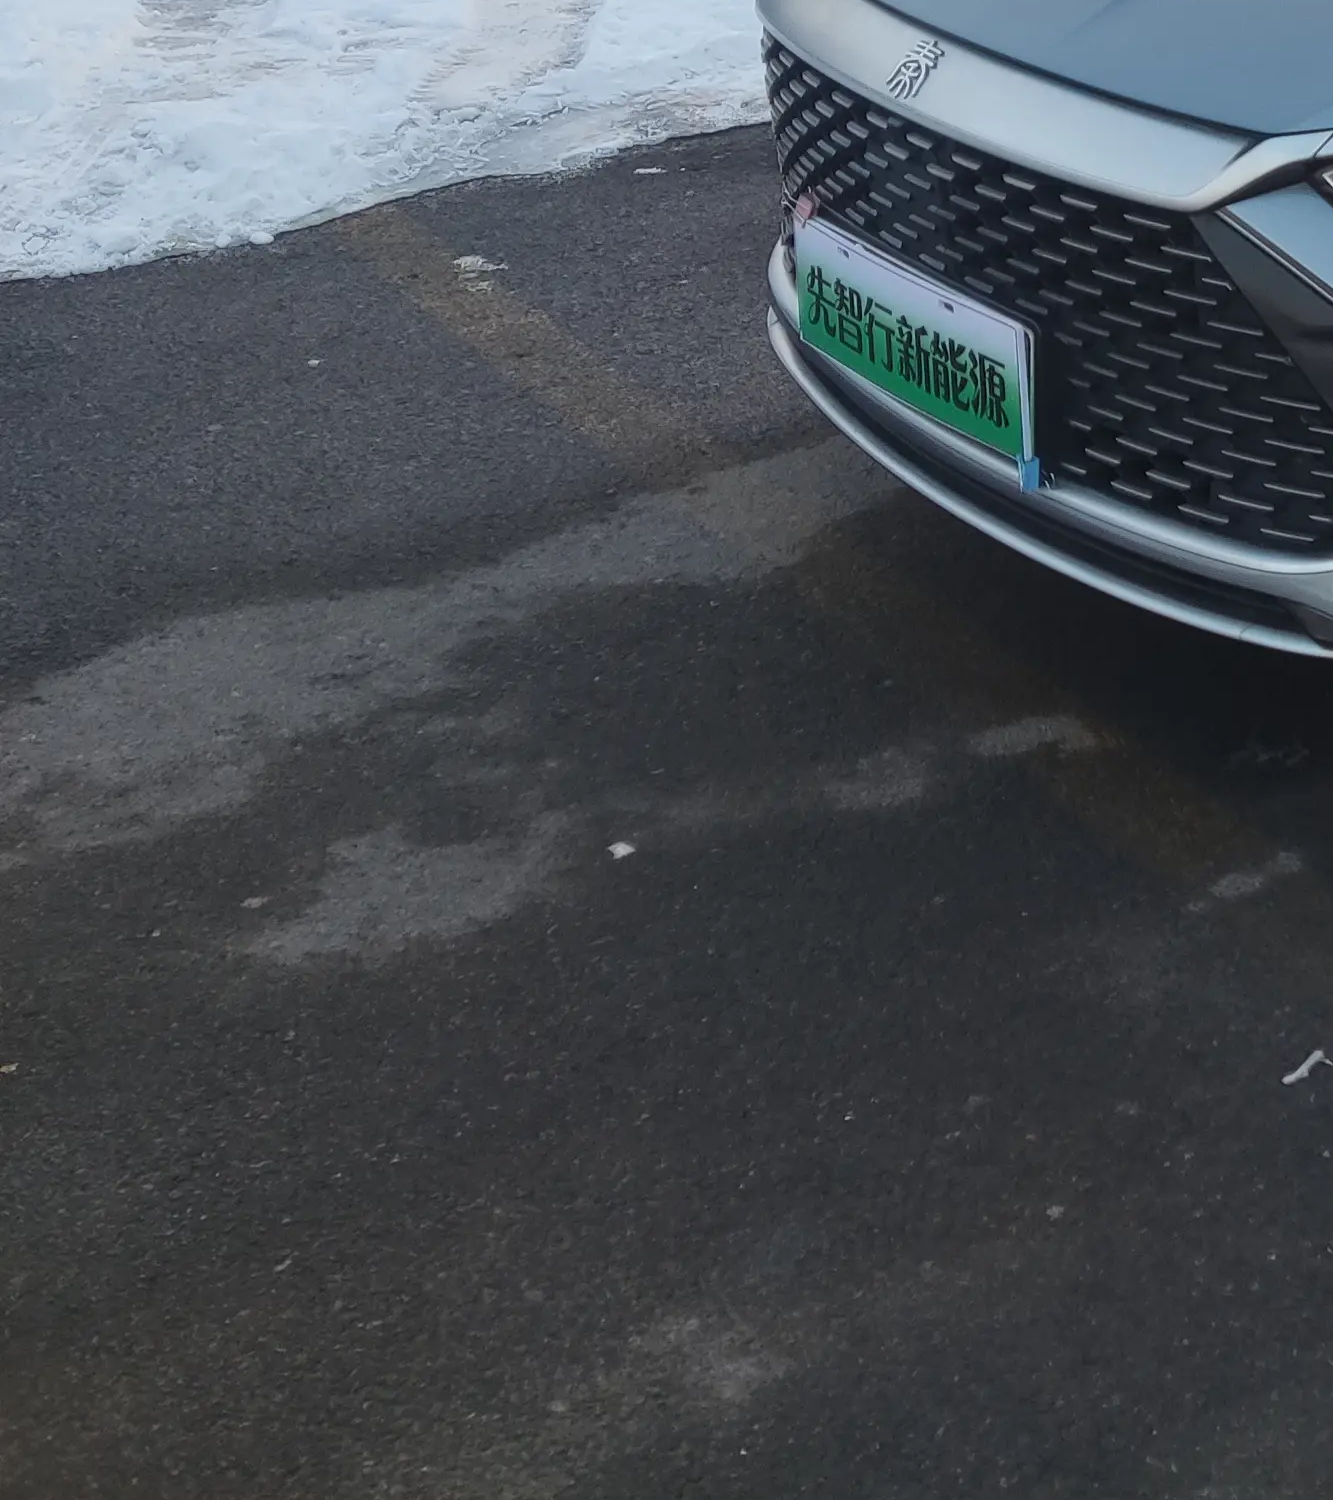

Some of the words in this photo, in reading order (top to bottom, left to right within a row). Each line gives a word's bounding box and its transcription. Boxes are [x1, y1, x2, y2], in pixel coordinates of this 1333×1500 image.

[806, 265, 1010, 429] 先智行新能源
